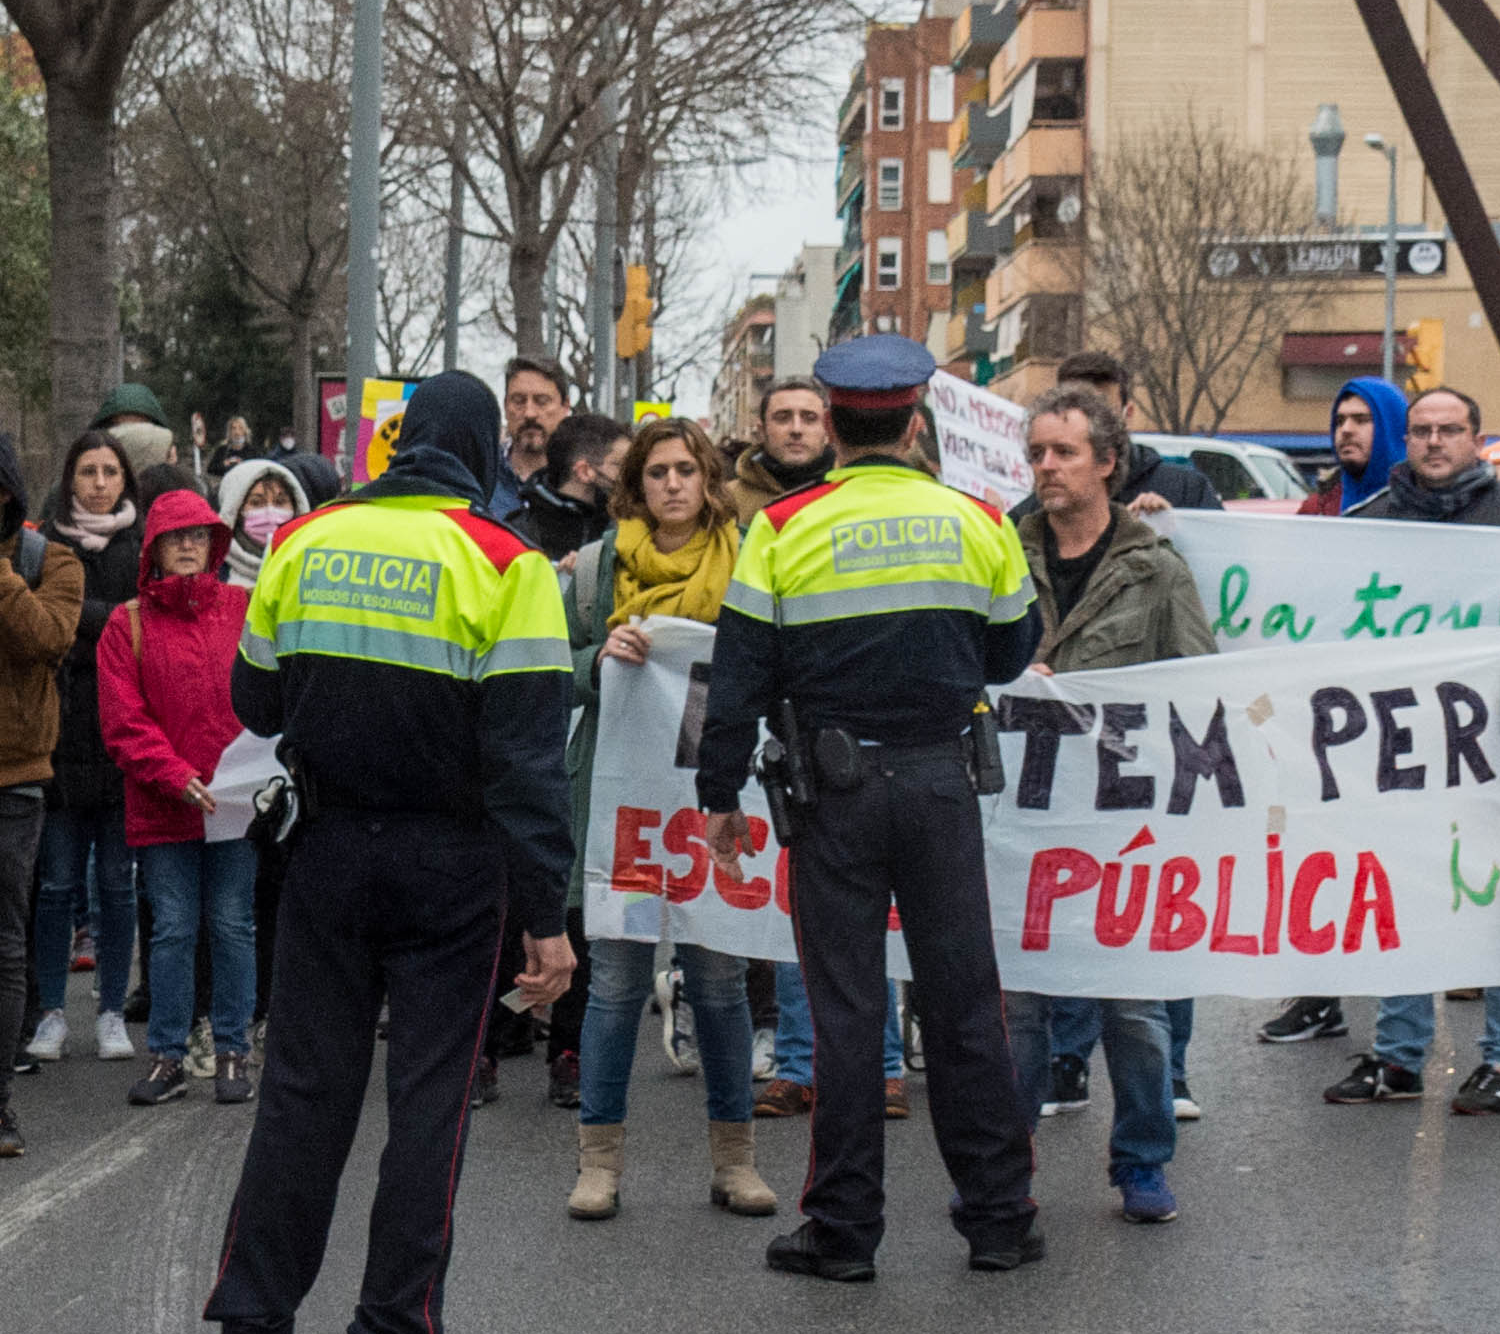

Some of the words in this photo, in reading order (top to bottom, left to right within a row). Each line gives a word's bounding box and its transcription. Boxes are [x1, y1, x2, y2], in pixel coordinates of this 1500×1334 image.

[835, 519, 959, 552] POLICIA
[303, 587, 350, 603] MOSSOS
[304, 552, 432, 595] POLICIA
[1212, 564, 1315, 642] la
[1311, 679, 1496, 802] PER
[1020, 824, 1401, 957] PÚBLICA
